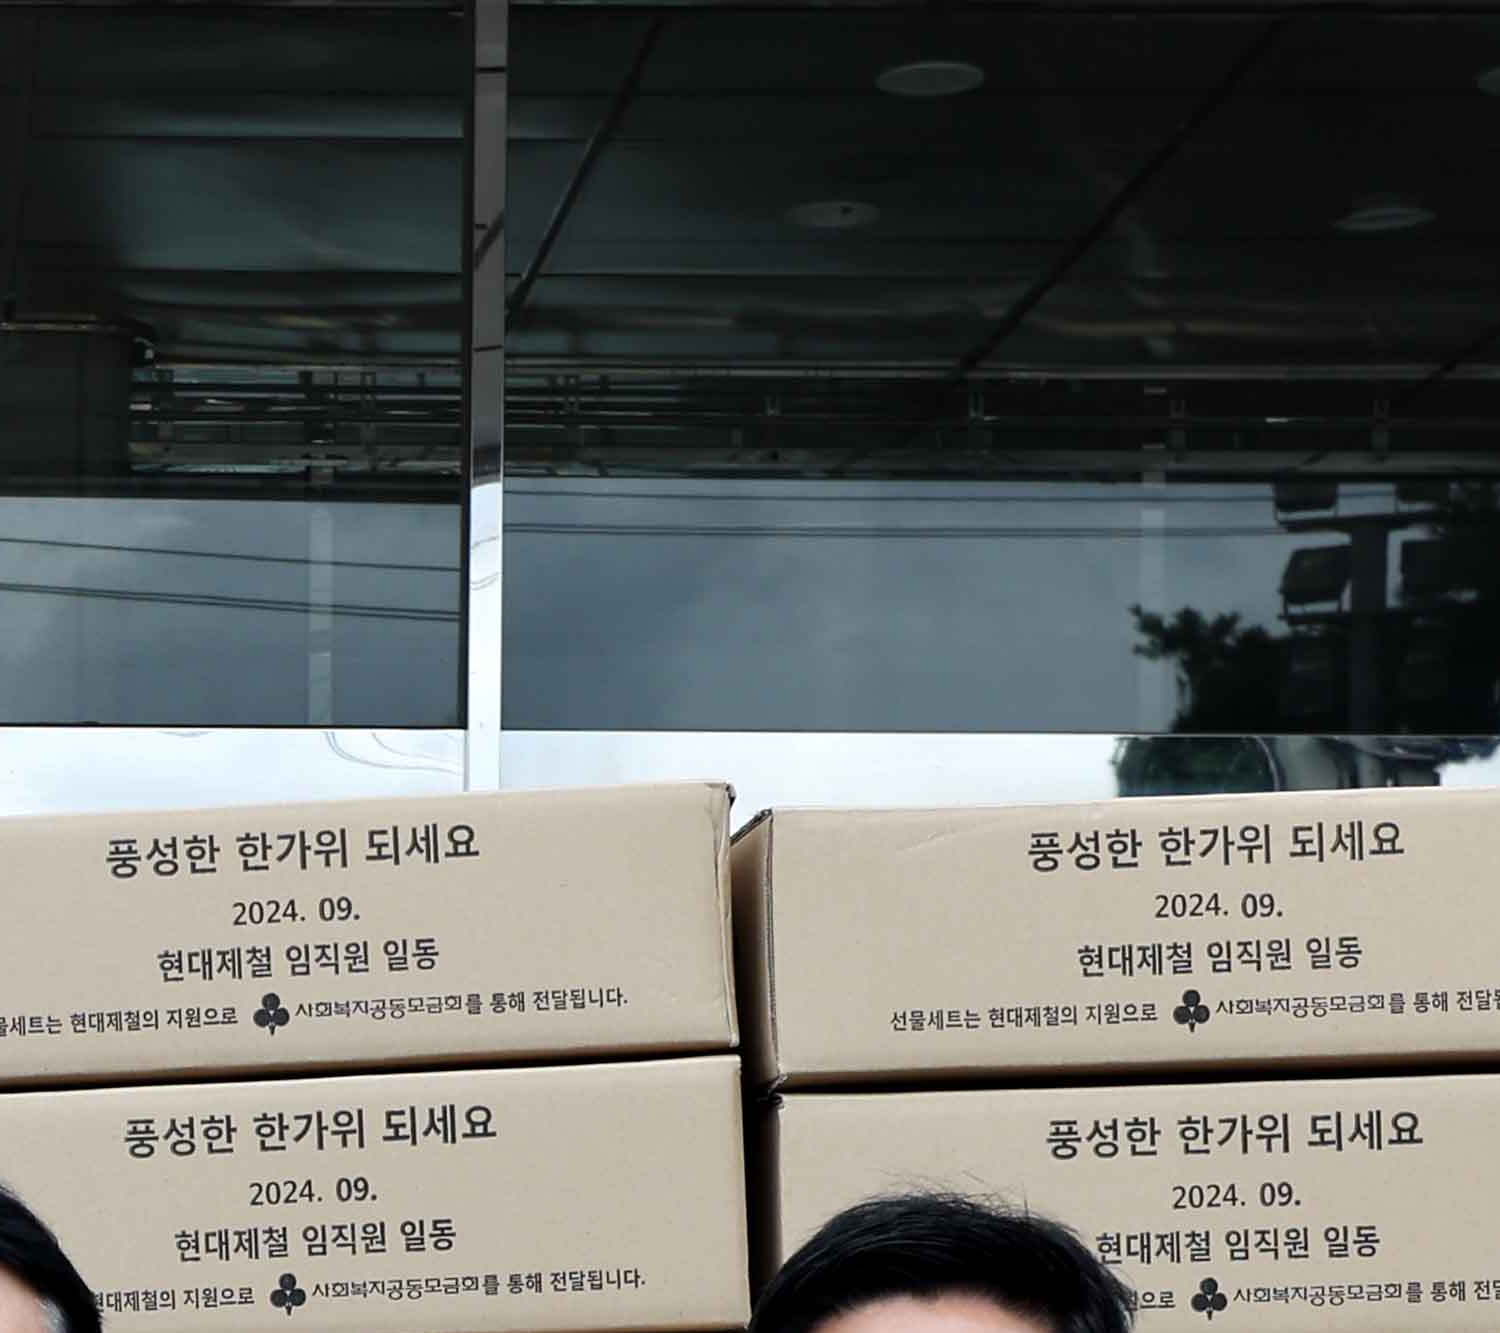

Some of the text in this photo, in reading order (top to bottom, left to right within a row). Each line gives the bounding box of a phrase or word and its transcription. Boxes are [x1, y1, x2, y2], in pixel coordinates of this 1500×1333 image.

[105, 822, 481, 879] 풍성한 한가위 되세요
[1027, 819, 1405, 873] 풍성한 한가위 되세요
[232, 895, 361, 927] 2024. 09.
[156, 937, 440, 983] 현대제철 임직원 일동
[69, 1008, 159, 1034] 현대제철의
[165, 1006, 239, 1030] 지원으로
[489, 991, 526, 1014] 통해
[532, 986, 628, 1012] 전달됩니다.
